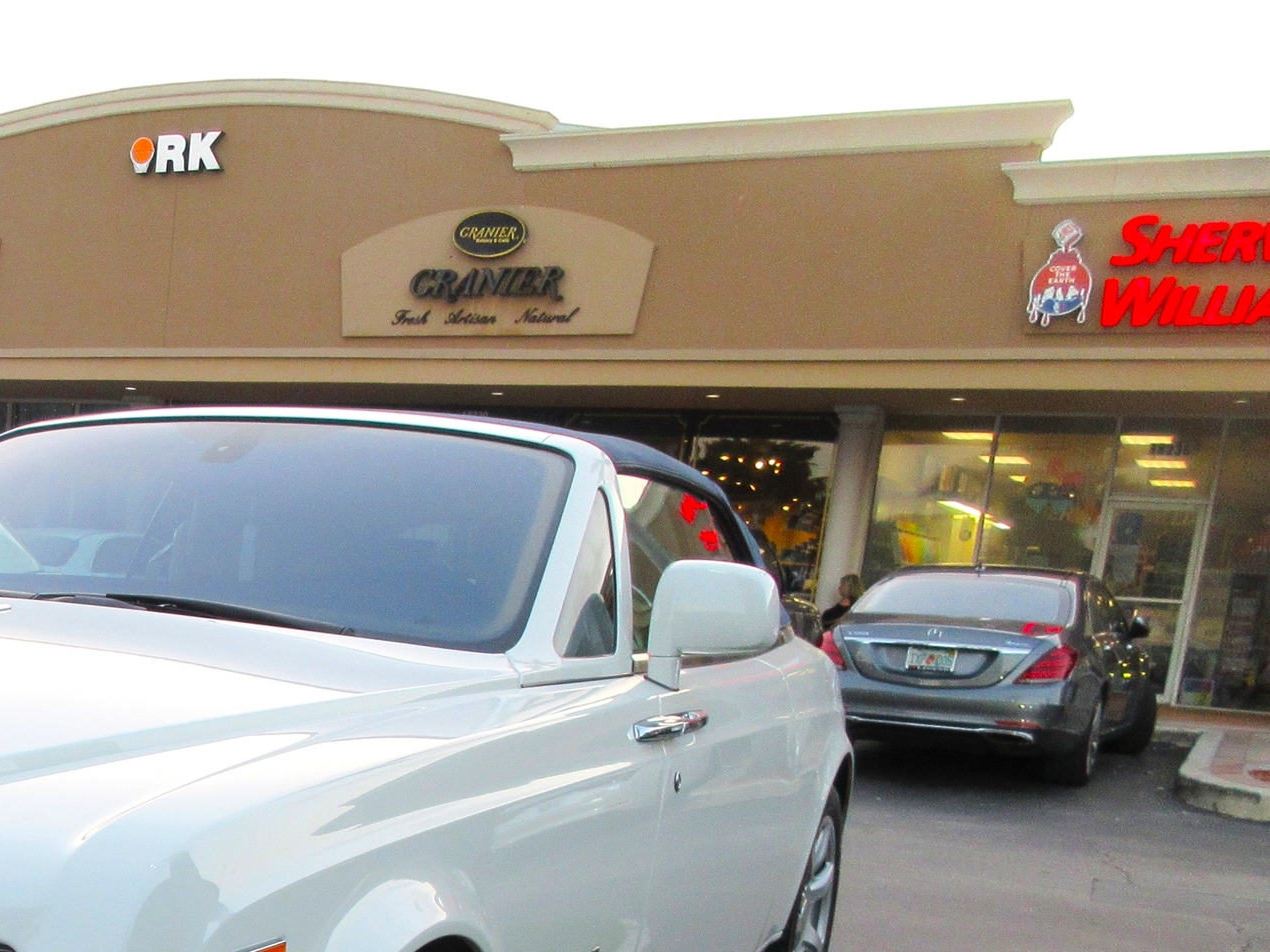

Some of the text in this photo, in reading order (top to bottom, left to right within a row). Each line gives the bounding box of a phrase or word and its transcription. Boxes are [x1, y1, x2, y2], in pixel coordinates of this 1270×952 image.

[1109, 214, 1270, 266] SHER
[391, 306, 581, 326] Fresh Artisan Natural
